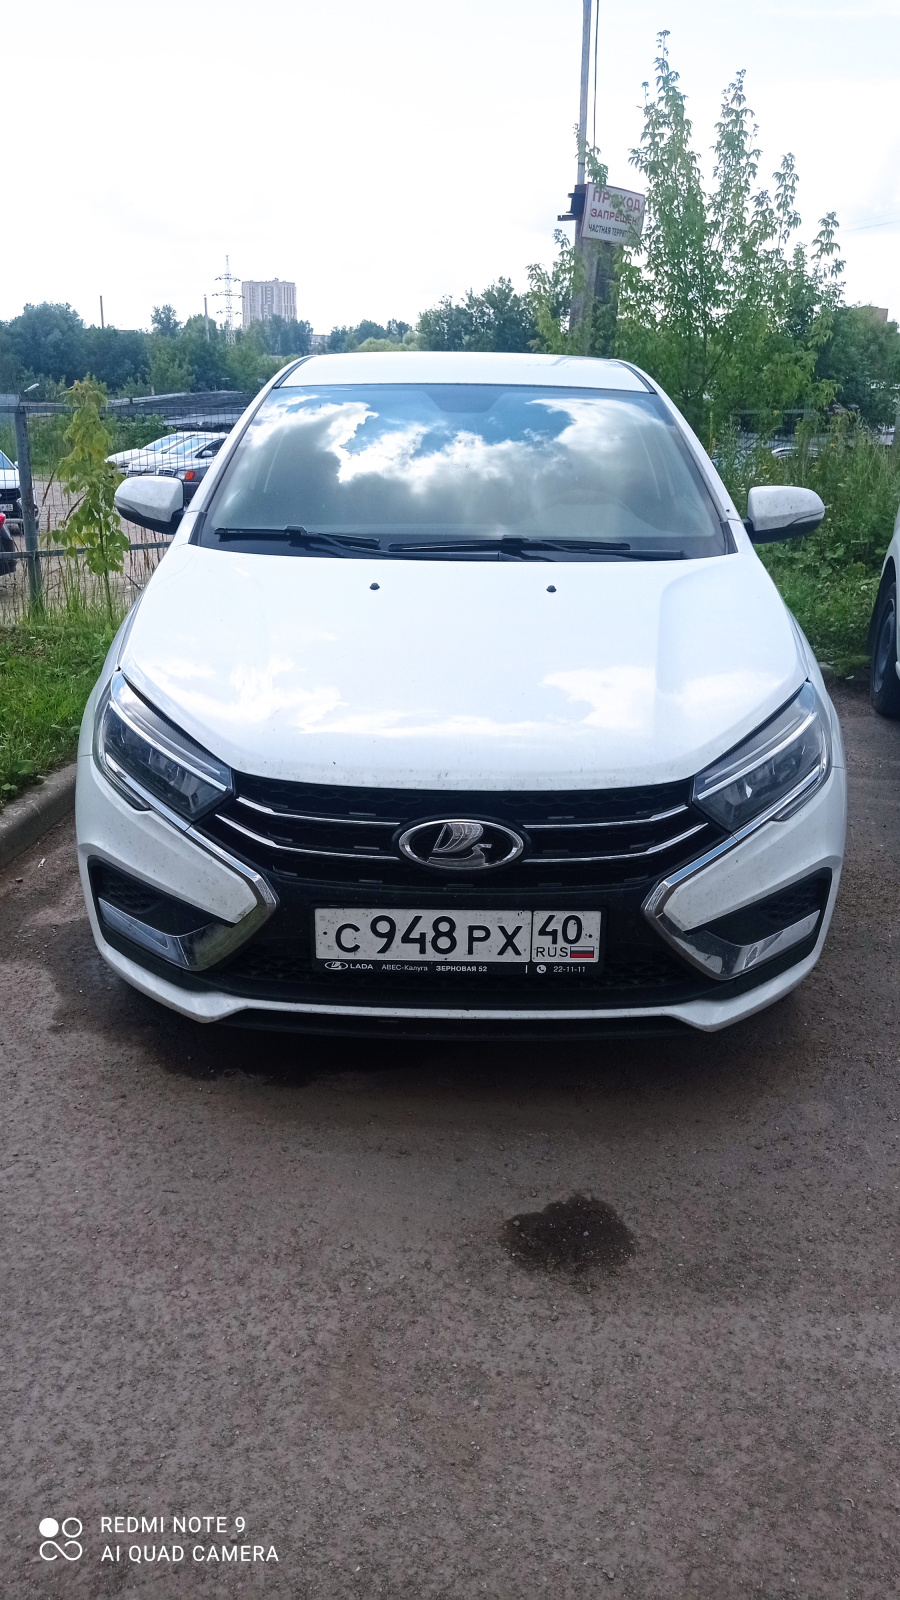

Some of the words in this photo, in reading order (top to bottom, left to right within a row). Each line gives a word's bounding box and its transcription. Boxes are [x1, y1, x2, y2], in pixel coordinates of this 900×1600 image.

[593, 189, 640, 213] ПРХОД
[588, 224, 611, 235] ЧАСТНАЯ
[538, 914, 583, 944] 40
[536, 947, 568, 957] RUS
